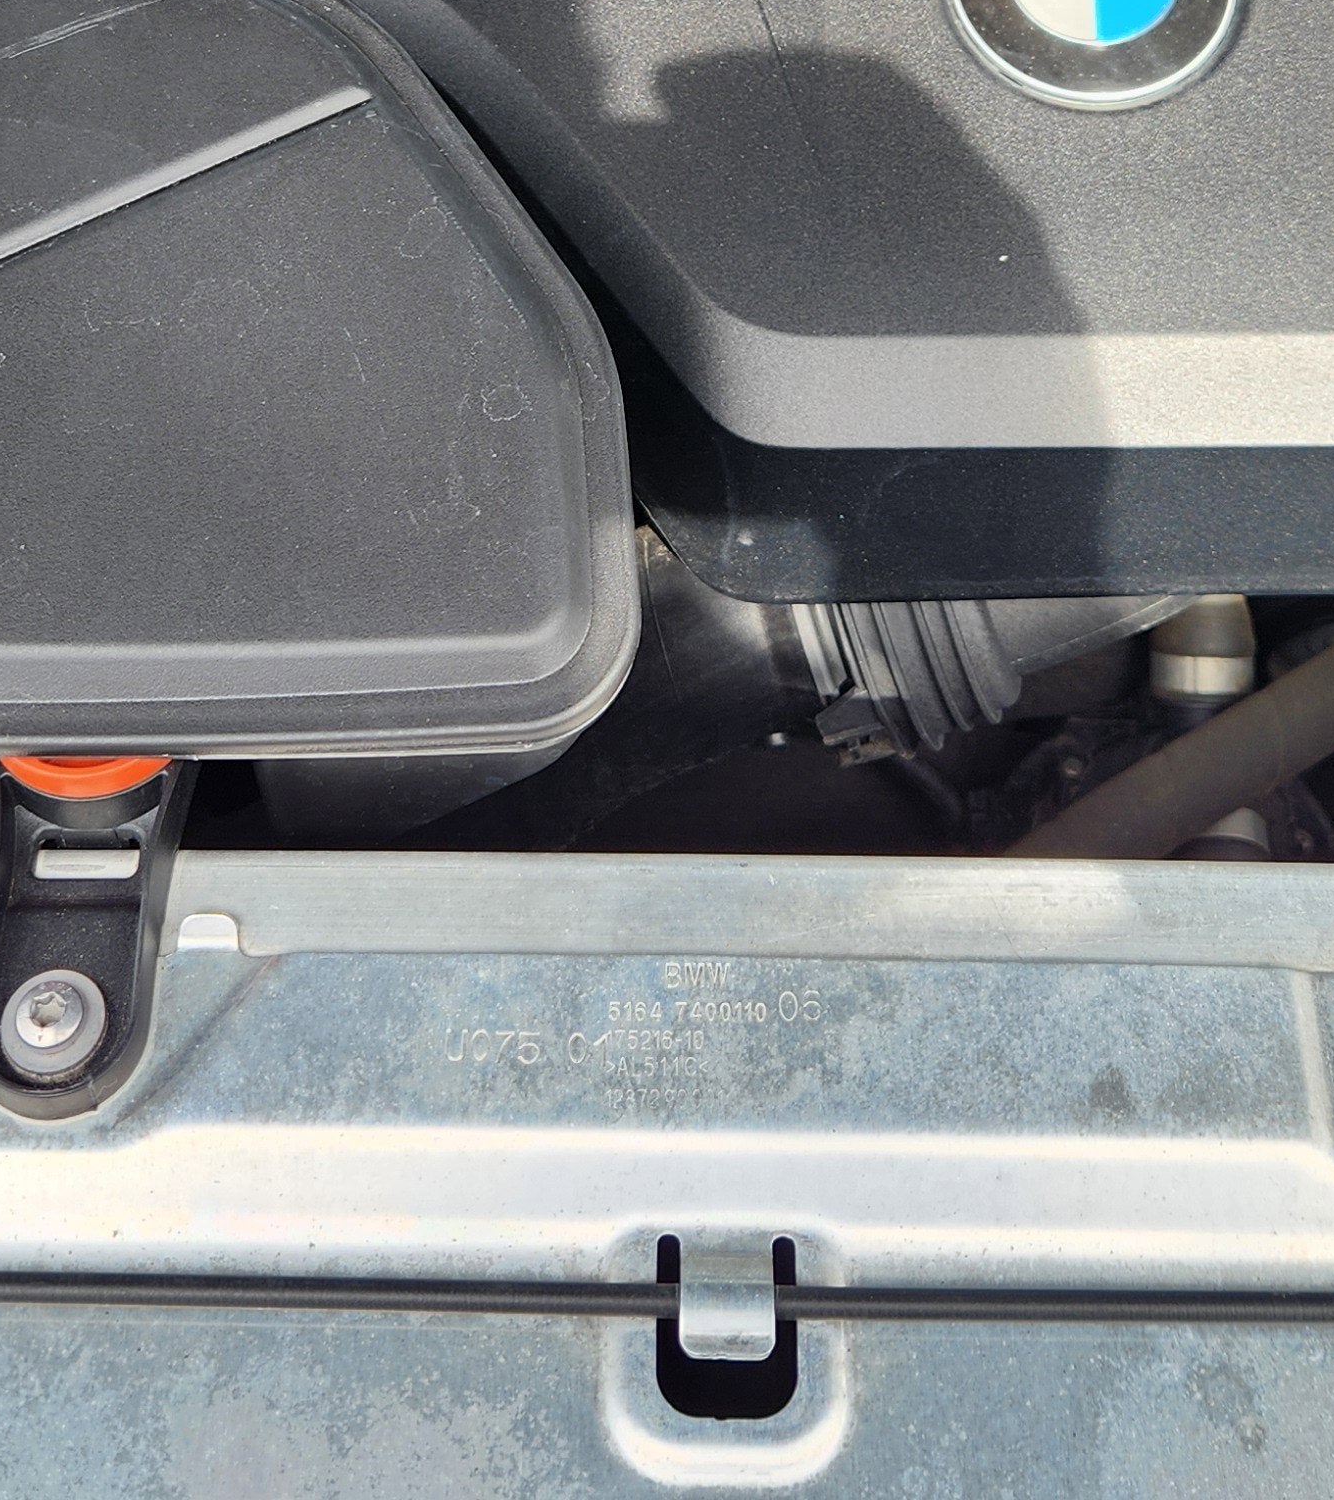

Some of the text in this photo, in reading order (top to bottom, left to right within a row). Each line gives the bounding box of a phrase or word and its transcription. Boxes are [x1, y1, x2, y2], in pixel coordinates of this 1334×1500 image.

[665, 961, 732, 988] BMW
[608, 1001, 662, 1022] 5164
[675, 1002, 767, 1022] 7400110
